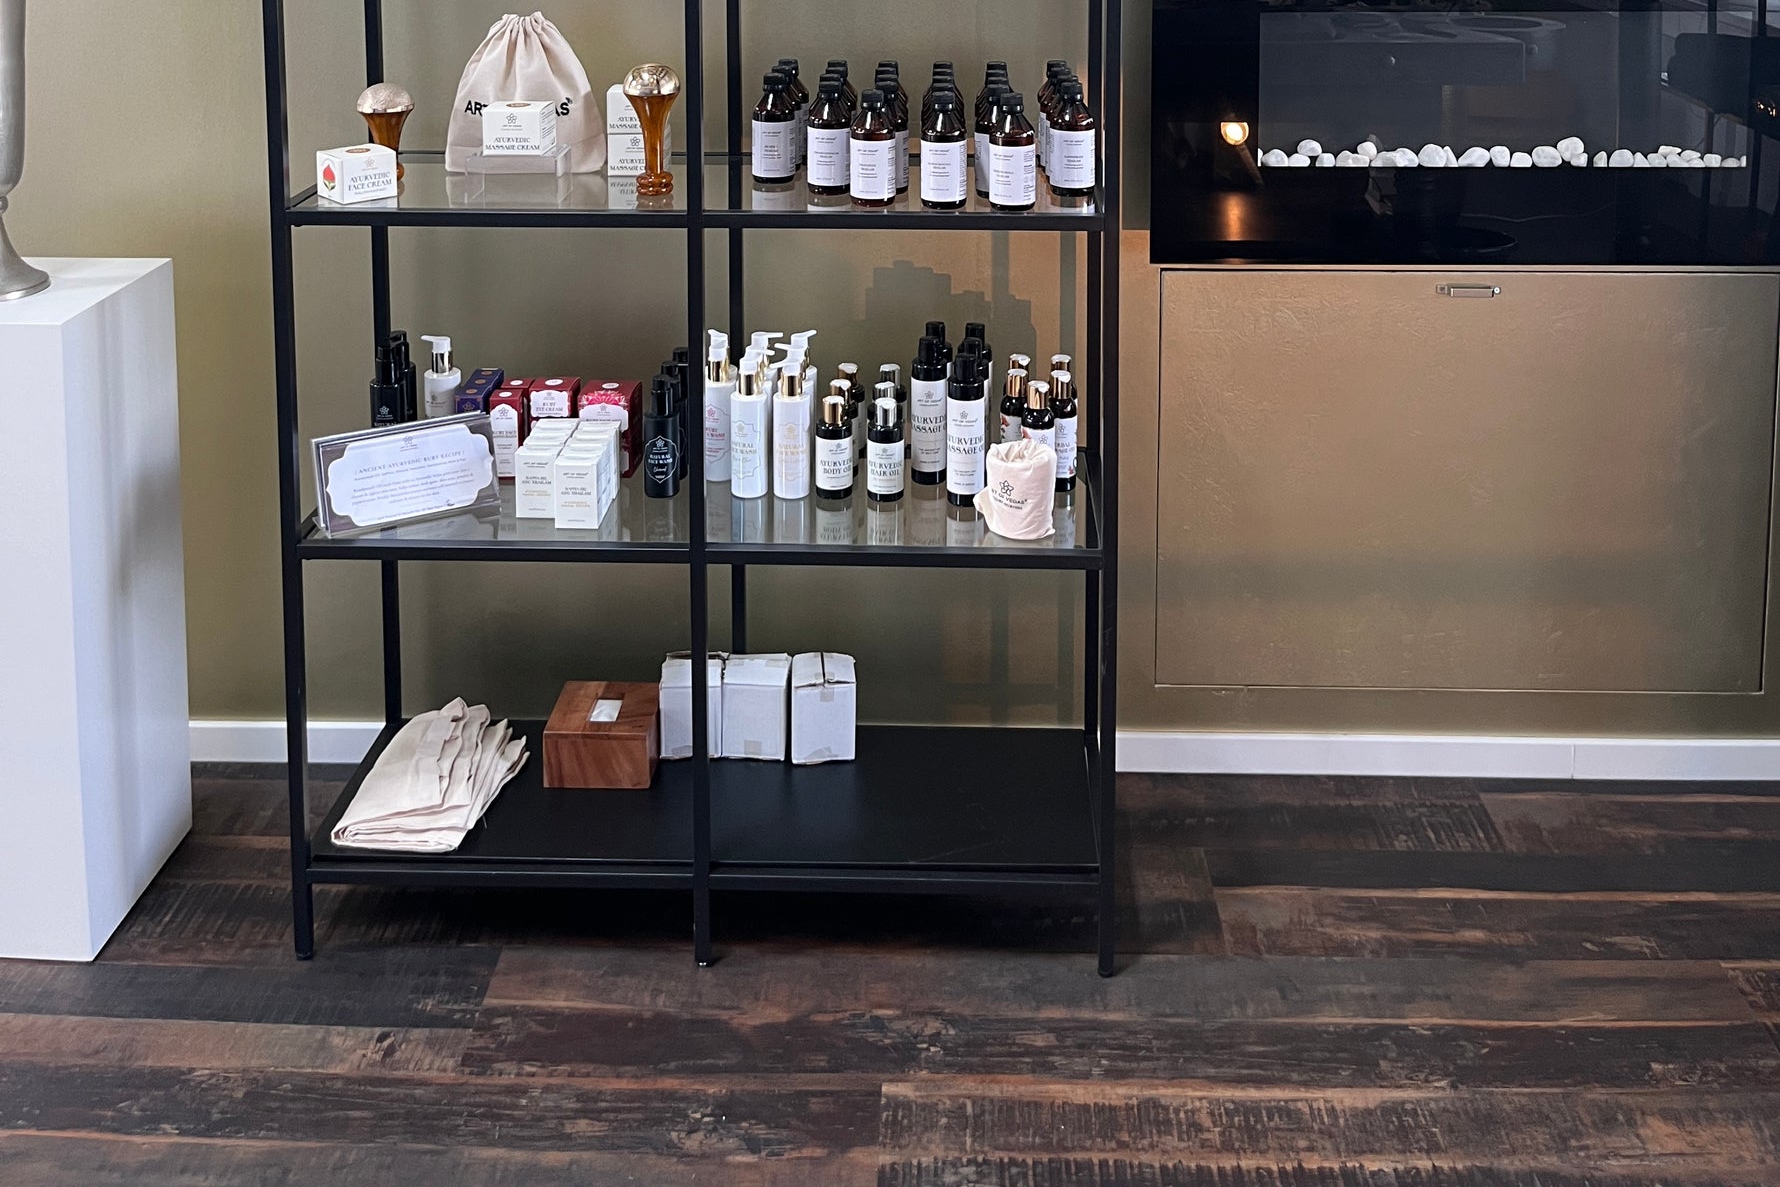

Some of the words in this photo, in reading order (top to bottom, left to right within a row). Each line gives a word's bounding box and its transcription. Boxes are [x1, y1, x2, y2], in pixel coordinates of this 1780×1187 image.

[350, 171, 391, 183] AYURVEDIC
[348, 183, 366, 192] FACE
[366, 178, 392, 189] CREAM
[388, 457, 422, 469] AYURVEDIC
[823, 467, 841, 475] BODY
[870, 468, 888, 477] HAIR
[888, 469, 900, 477] OIL
